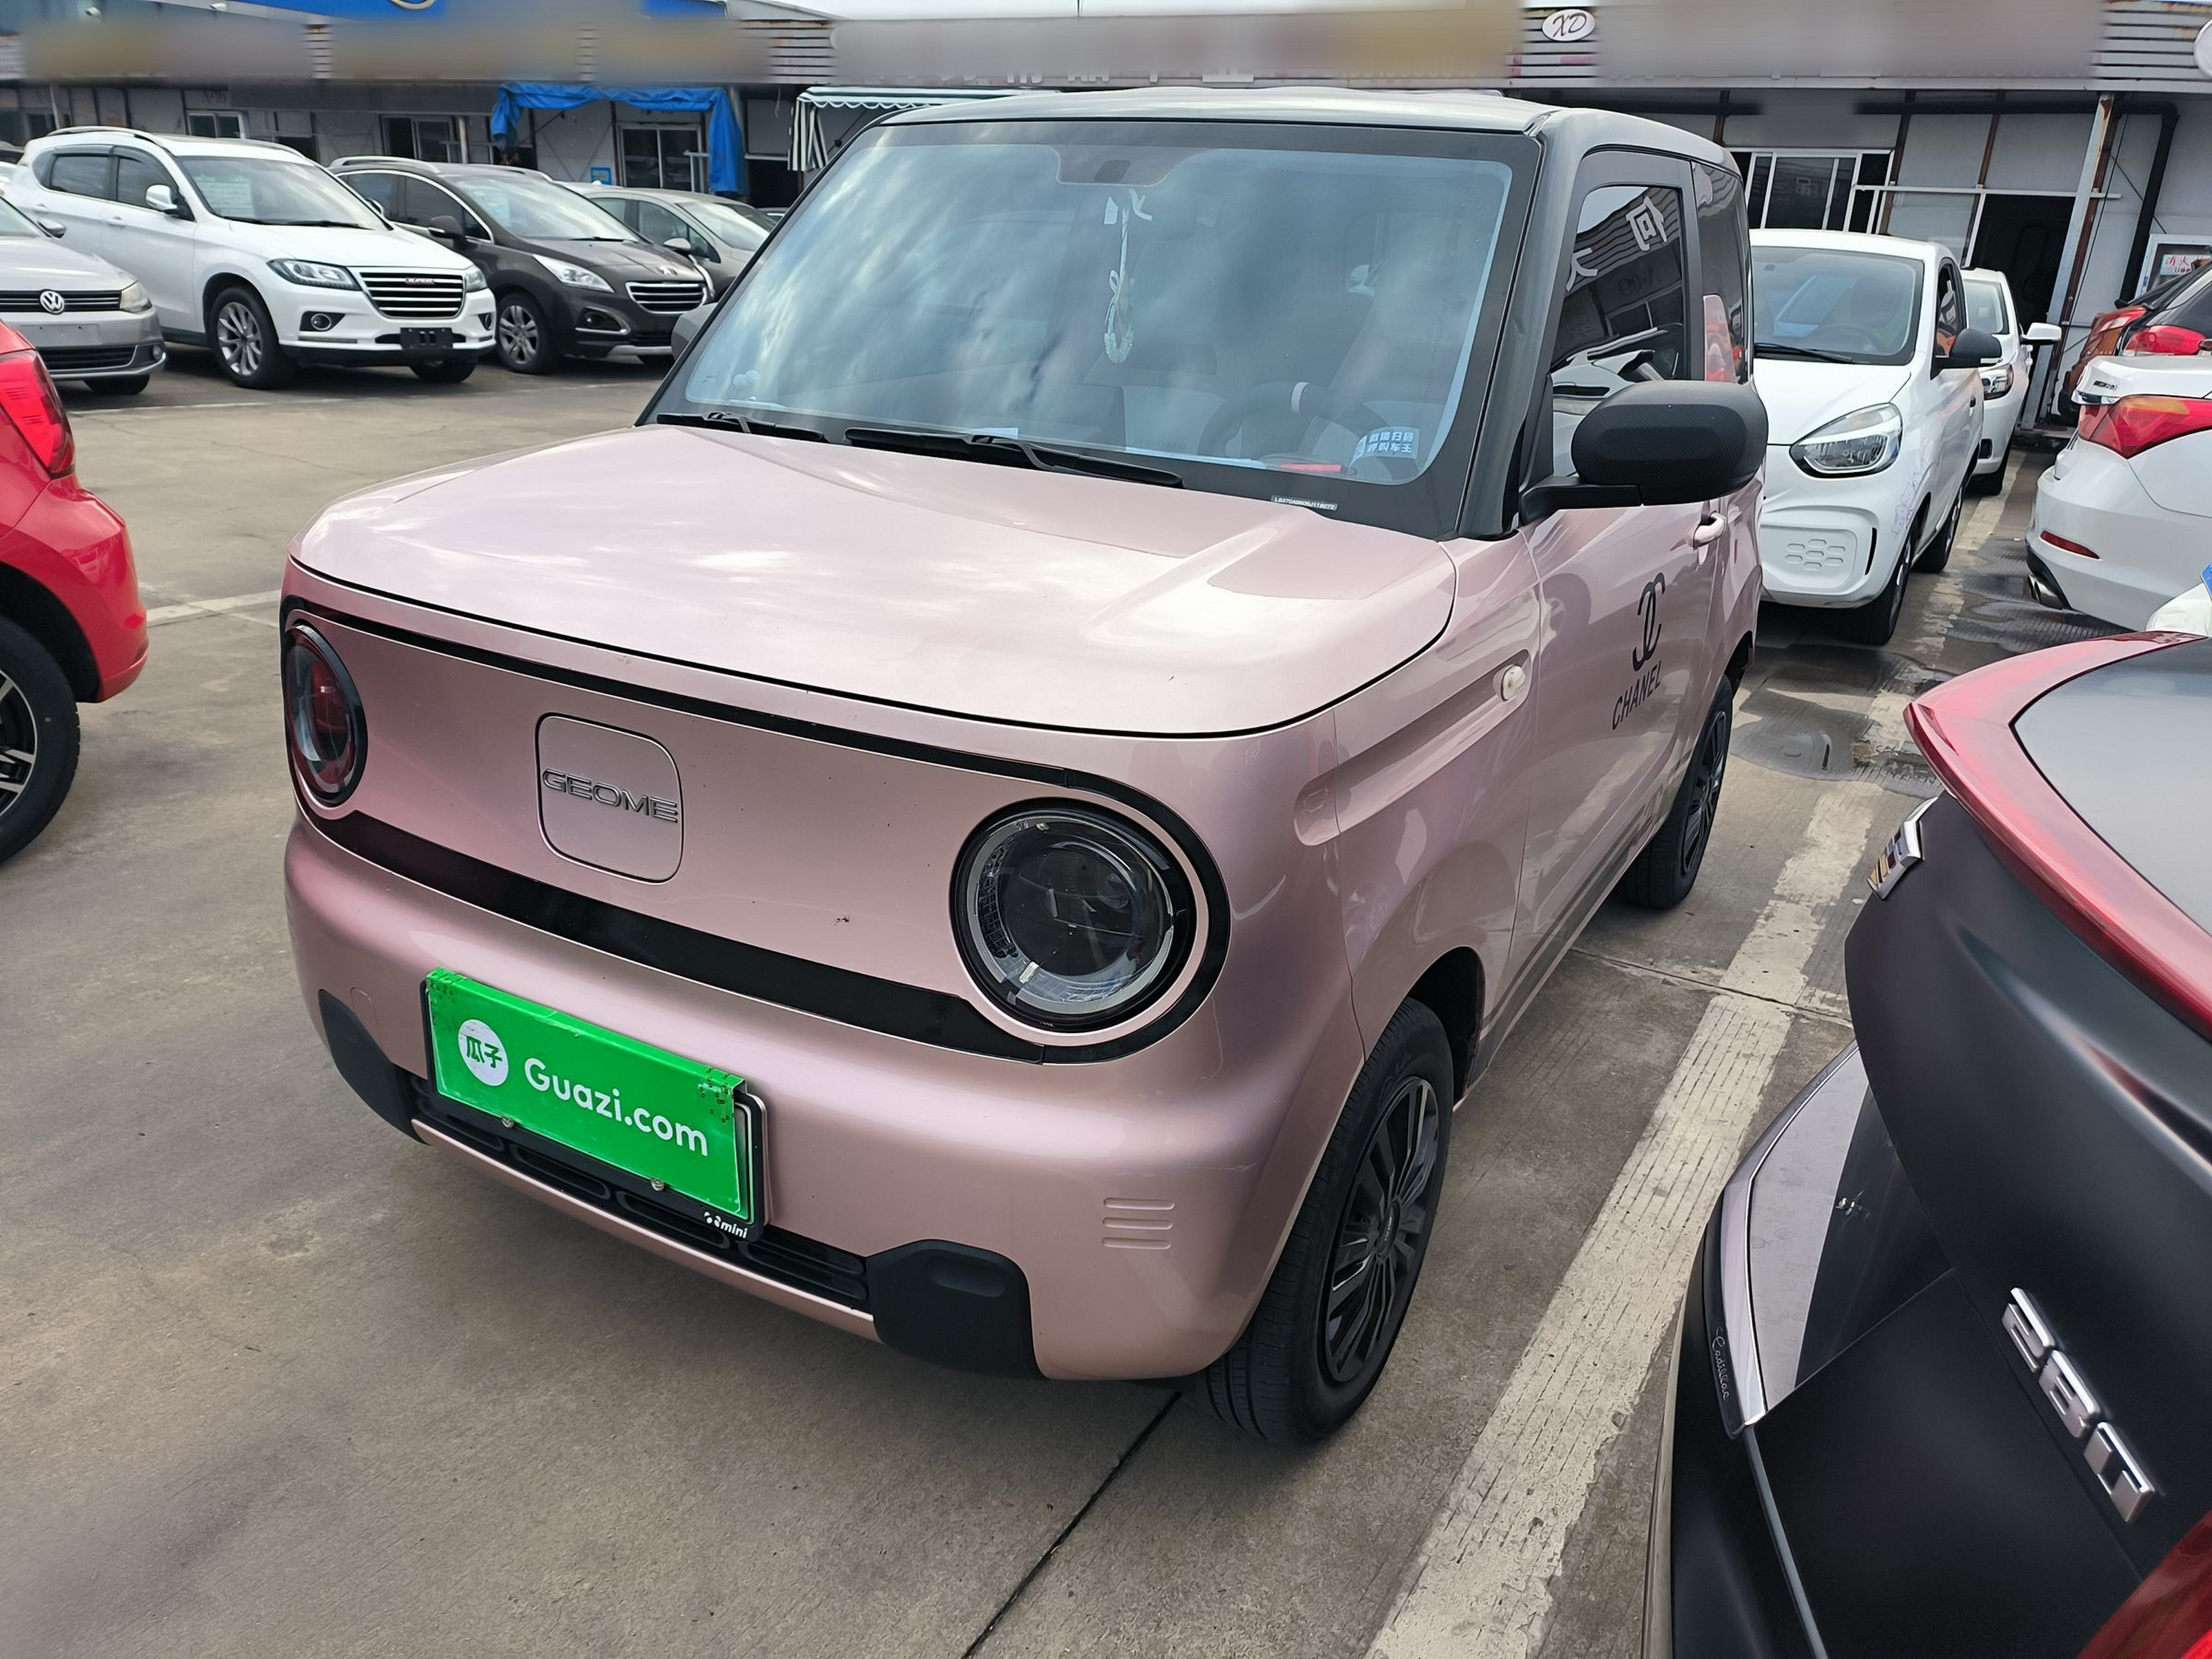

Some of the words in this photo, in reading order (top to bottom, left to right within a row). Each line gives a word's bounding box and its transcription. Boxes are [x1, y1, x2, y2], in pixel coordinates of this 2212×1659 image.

[1552, 13, 1587, 37] XD
[1612, 660, 1661, 730] CHANEL
[542, 768, 679, 823] GEOME
[465, 1035, 503, 1068] 瓜子
[524, 1058, 708, 1156] Guazi.com
[1712, 1327, 1730, 1401] Cadillac
[2001, 1287, 2155, 1523] 28T
